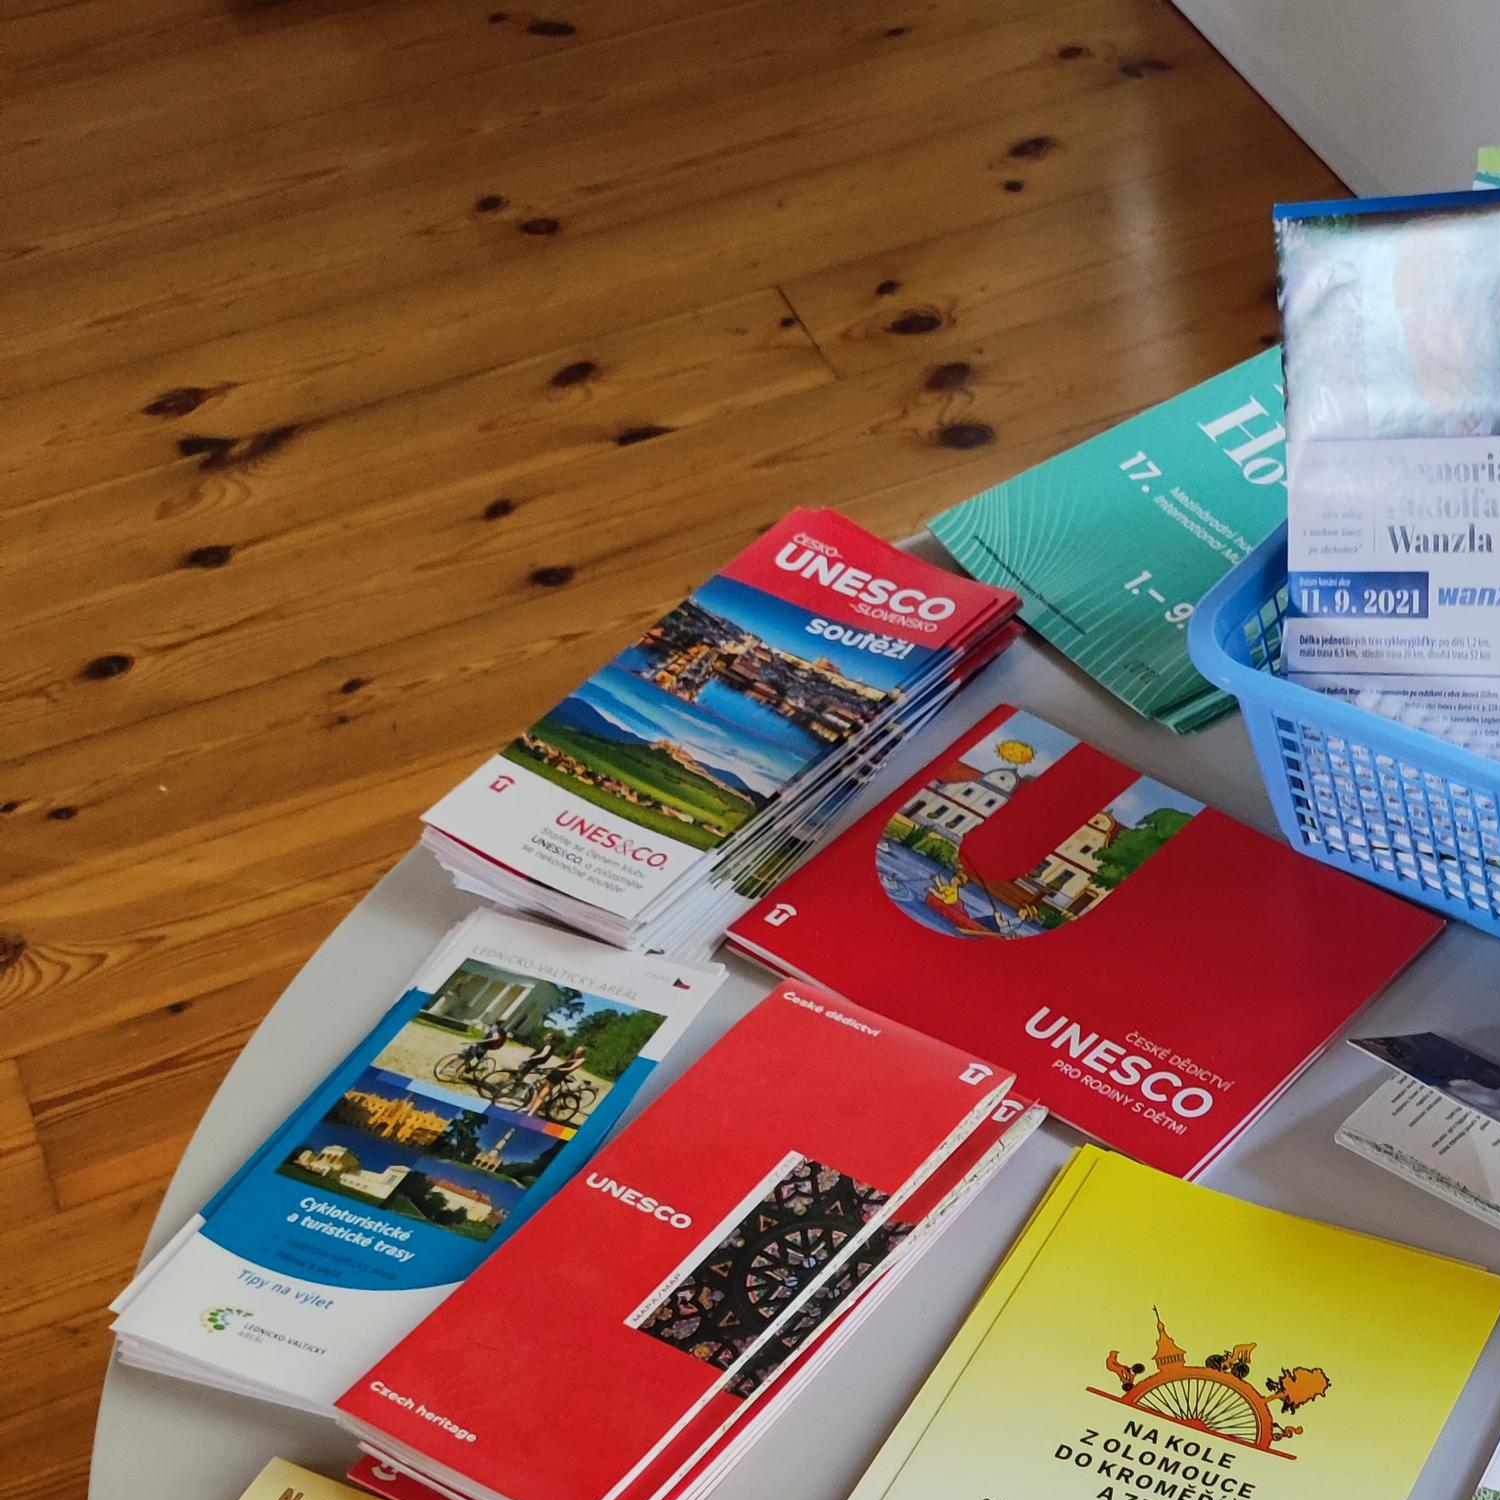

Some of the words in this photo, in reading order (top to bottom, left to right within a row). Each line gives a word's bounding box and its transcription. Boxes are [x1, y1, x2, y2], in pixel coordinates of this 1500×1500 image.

[1119, 450, 1162, 493] 17.
[1387, 523, 1494, 553] Wanzla
[775, 542, 956, 620] UNESCO
[1124, 571, 1152, 595] 1.
[1299, 589, 1328, 614] 11.
[1335, 588, 1357, 614] 9.
[1364, 588, 1421, 614] 2021
[805, 618, 917, 660] soutěž!
[556, 810, 668, 871] UNES&CO.
[783, 990, 823, 1015] České
[825, 1009, 882, 1038] dědictví
[1024, 1005, 1214, 1119] UNESCO
[1125, 1030, 1168, 1060] ČESKÉ
[1167, 1048, 1235, 1093] DĚDICTVÍ
[1051, 1059, 1080, 1081] PRO
[1079, 1072, 1130, 1107] RODINY
[1130, 1099, 1144, 1114] S
[1142, 1105, 1187, 1136] DĚTMI
[300, 1197, 414, 1242] Cykloturistické
[586, 1172, 693, 1230] UNESCO
[287, 1212, 299, 1223] a
[301, 1216, 372, 1248] turistické
[374, 1241, 415, 1262] trasy
[237, 1269, 269, 1289] Tipy
[271, 1283, 291, 1296] na
[295, 1287, 334, 1310] výlet
[370, 1379, 415, 1411] Czech
[416, 1400, 477, 1444] heritage
[1054, 1444, 1093, 1468] DO
[1080, 1429, 1100, 1446] Z
[1103, 1438, 1256, 1500] OLOMOUCE
[1125, 1420, 1160, 1445] NA
[1165, 1434, 1236, 1470] KOLE
